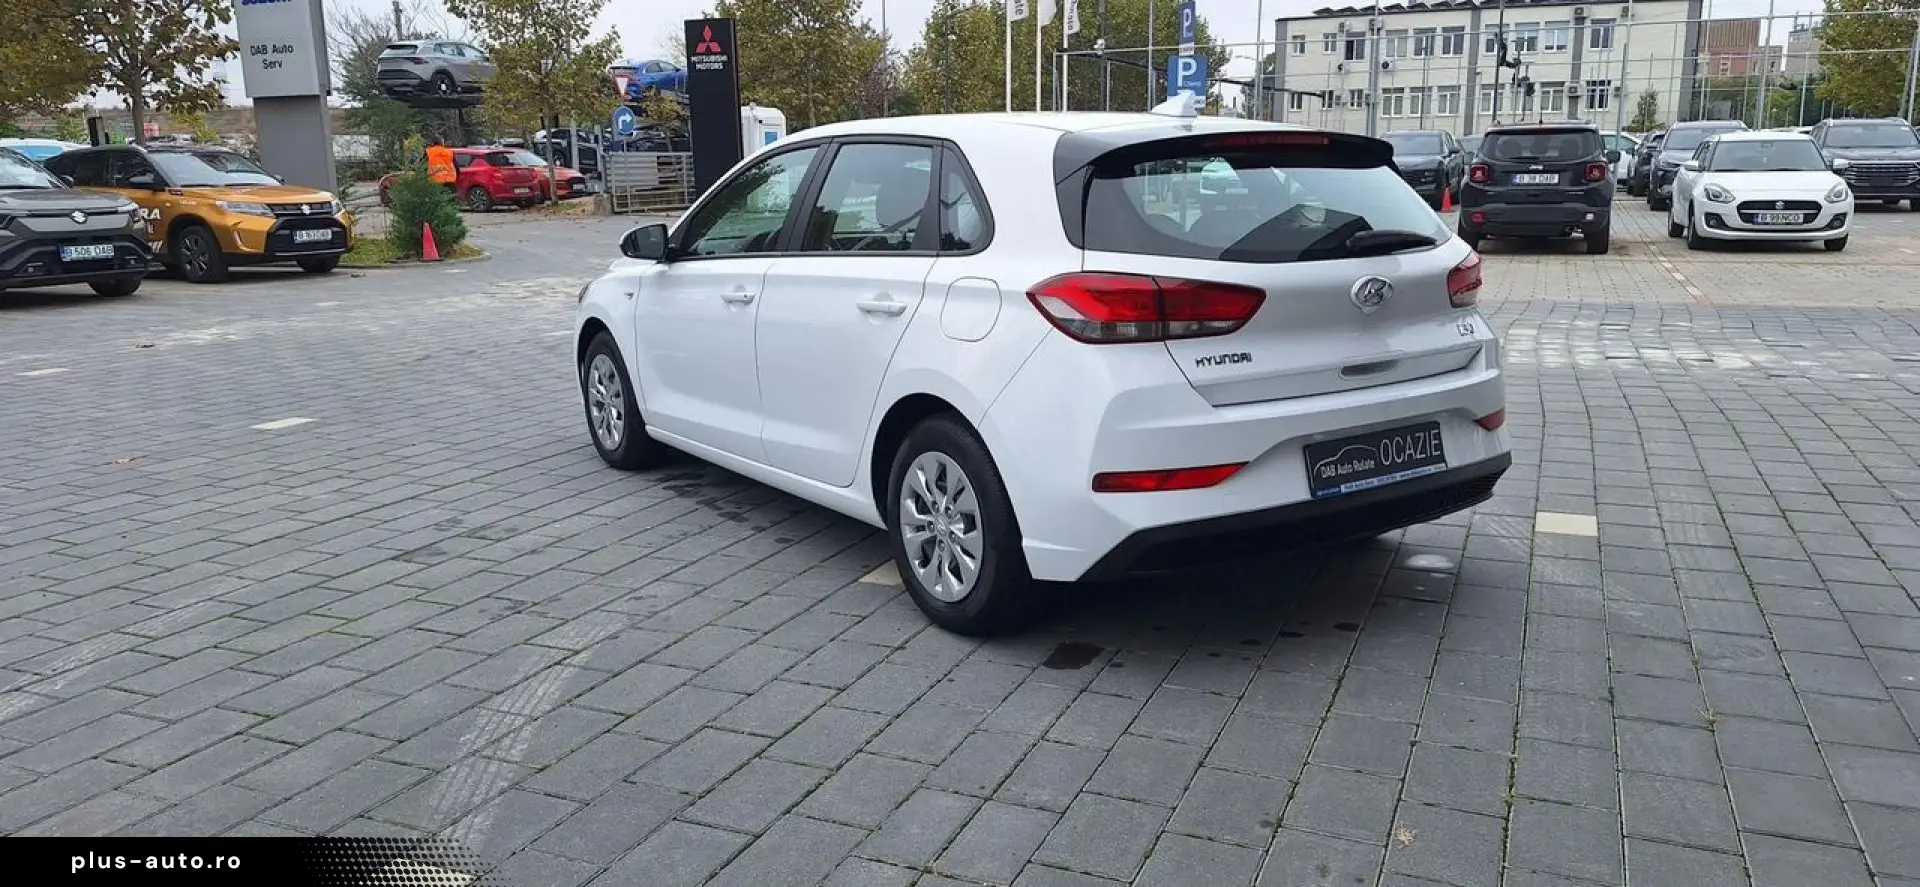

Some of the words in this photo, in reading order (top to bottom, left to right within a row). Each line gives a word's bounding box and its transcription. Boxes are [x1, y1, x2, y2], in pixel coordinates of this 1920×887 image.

[1183, 8, 1192, 37] P
[250, 44, 267, 56] DAB
[272, 43, 294, 54] Auto
[262, 59, 283, 69] Serv
[1177, 58, 1198, 87] P
[94, 245, 113, 255] DAB
[1195, 352, 1252, 368] HYUNDAI
[1380, 429, 1440, 465] OCAZIE
[1320, 466, 1336, 478] DAB
[1338, 463, 1353, 475] Auto
[1353, 459, 1375, 471] Rulate
